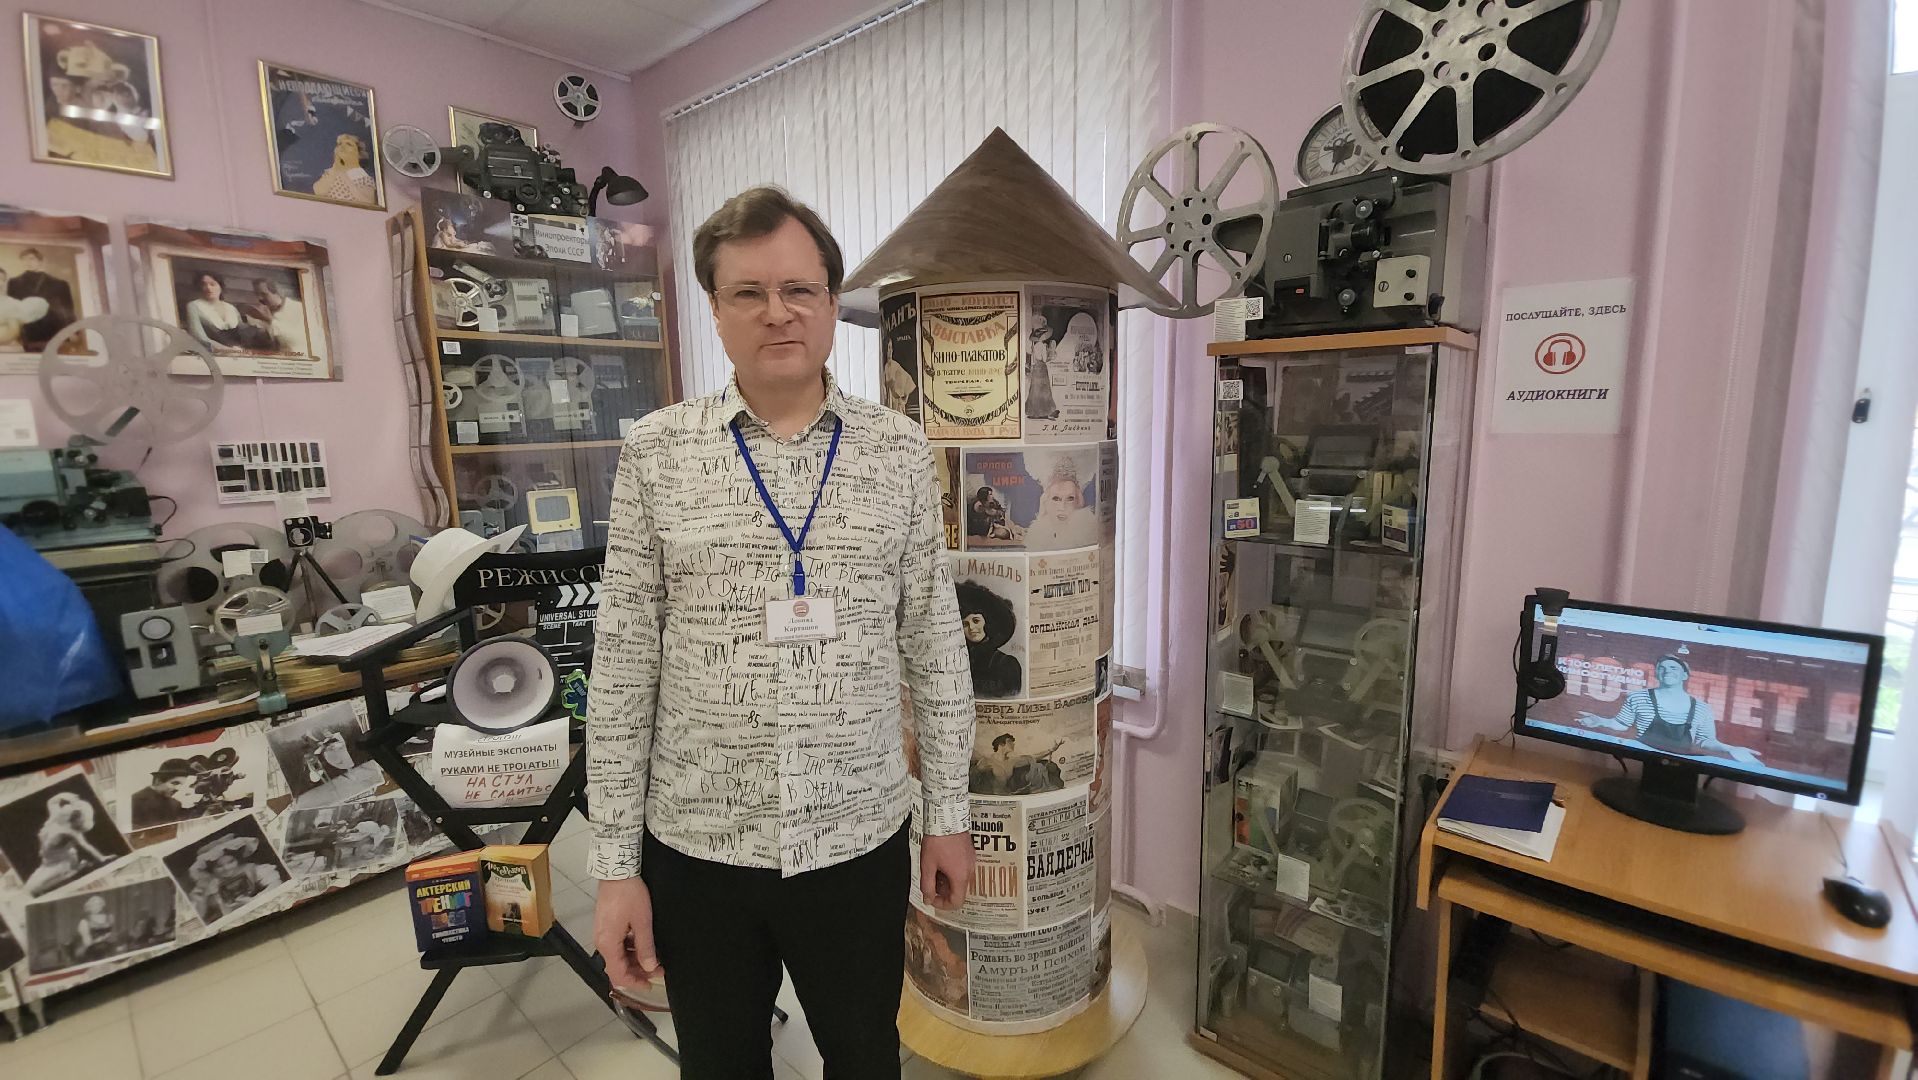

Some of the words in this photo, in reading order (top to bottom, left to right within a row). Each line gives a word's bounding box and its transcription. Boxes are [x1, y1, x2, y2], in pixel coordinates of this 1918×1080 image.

[567, 246, 585, 256] СССР
[1506, 307, 1585, 321] ПОСЛУШАЙТЕ,
[1588, 304, 1627, 316] ЗДЕСЬ
[932, 321, 1006, 344] ВЫСТАВКА
[934, 349, 1006, 363] КИНО-ПЛАКАТОВ
[1506, 388, 1609, 402] АУДИОКНИГИ
[540, 610, 576, 622] UNIVERSAL
[444, 749, 496, 758] МУЗЕЙНЫЕ
[497, 744, 557, 756] ЭКСПОНАТЫ
[441, 765, 485, 775] РУКАМИ
[487, 765, 500, 773] НЕ
[502, 759, 560, 772] ТРОГАТЬ!!!
[466, 776, 487, 788] НА
[491, 773, 533, 788] СТУЛ
[464, 790, 482, 800] НЕ
[490, 784, 553, 799] САДИТЬС
[970, 833, 1017, 852] ЕРТЪ
[1027, 836, 1094, 880] БАЯДЕРКА
[969, 862, 1018, 898] ИЦКОЙ
[416, 880, 471, 898] АКТЕРСКИЙ
[971, 951, 1012, 962] Романъ
[1014, 954, 1026, 962] во
[978, 964, 1028, 976] Амуръ
